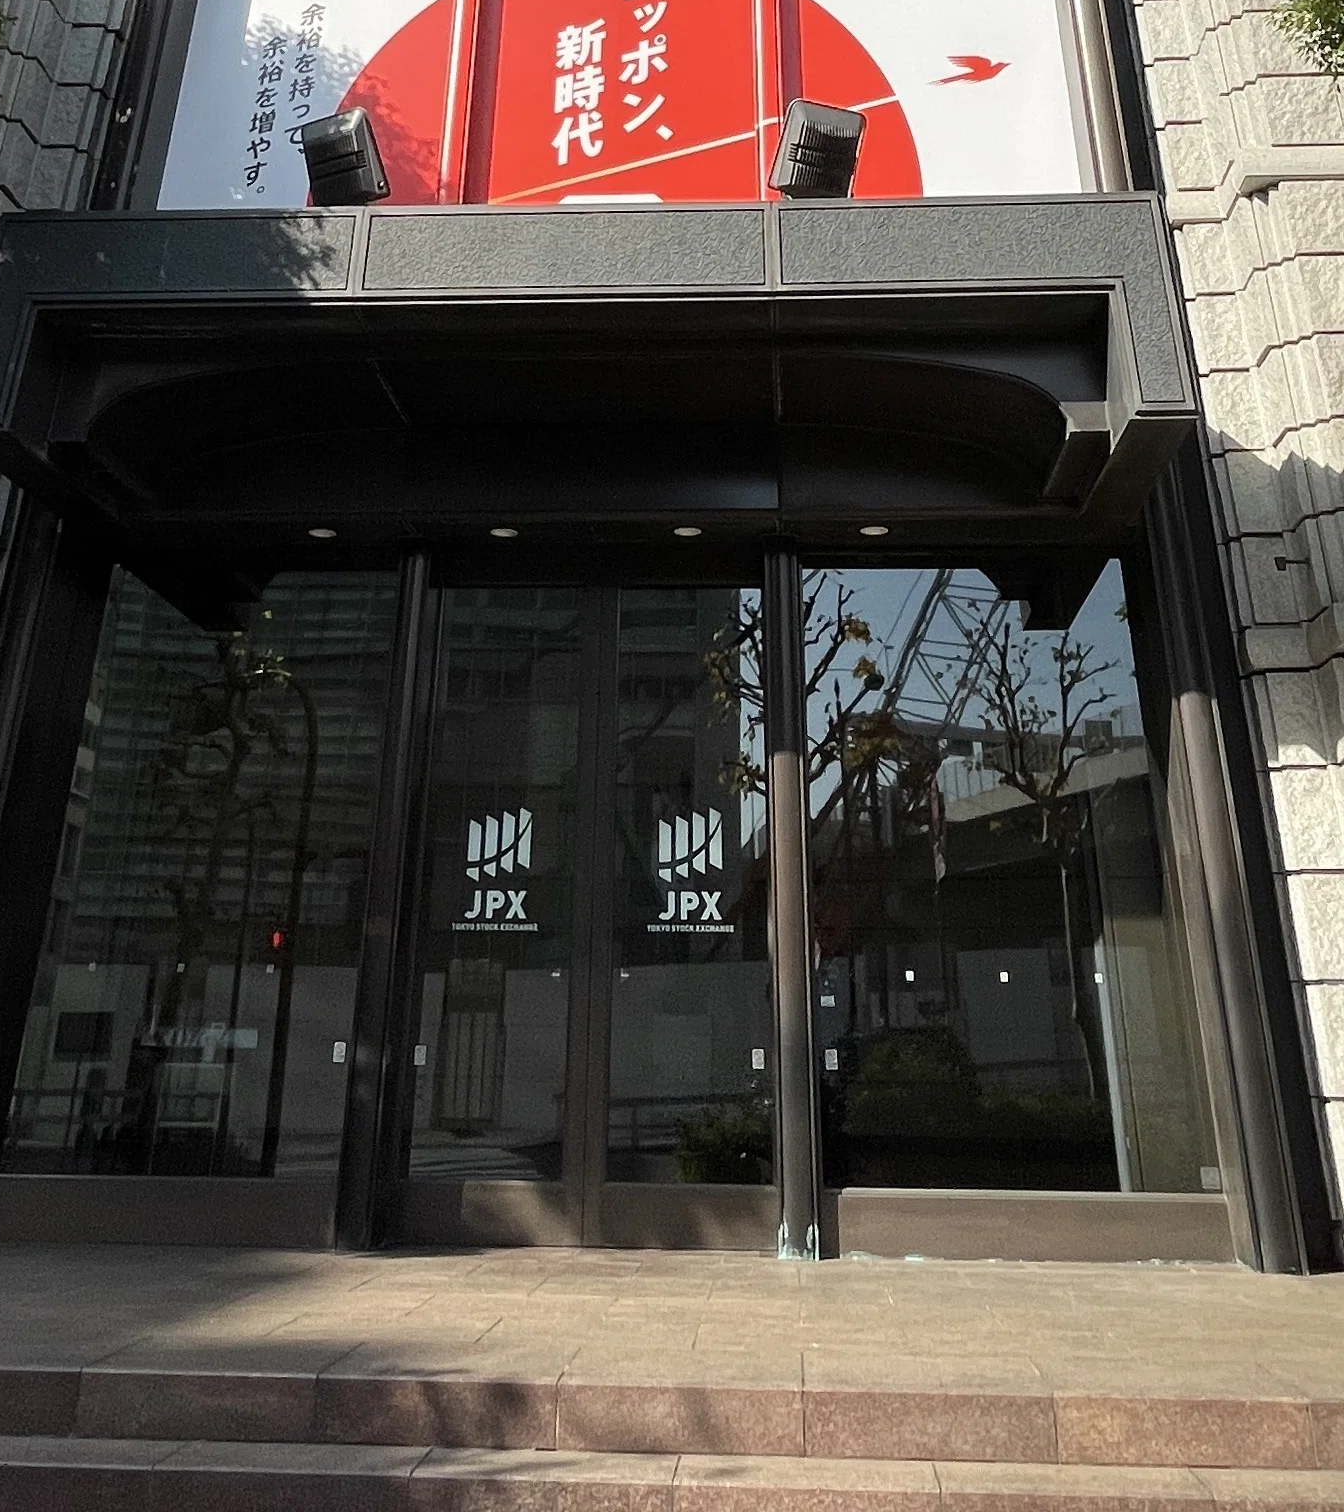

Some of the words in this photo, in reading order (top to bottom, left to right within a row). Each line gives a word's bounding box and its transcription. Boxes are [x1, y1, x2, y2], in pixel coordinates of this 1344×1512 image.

[550, 17, 607, 166] 新時代
[463, 889, 528, 920] JPX
[657, 890, 723, 921] JPX
